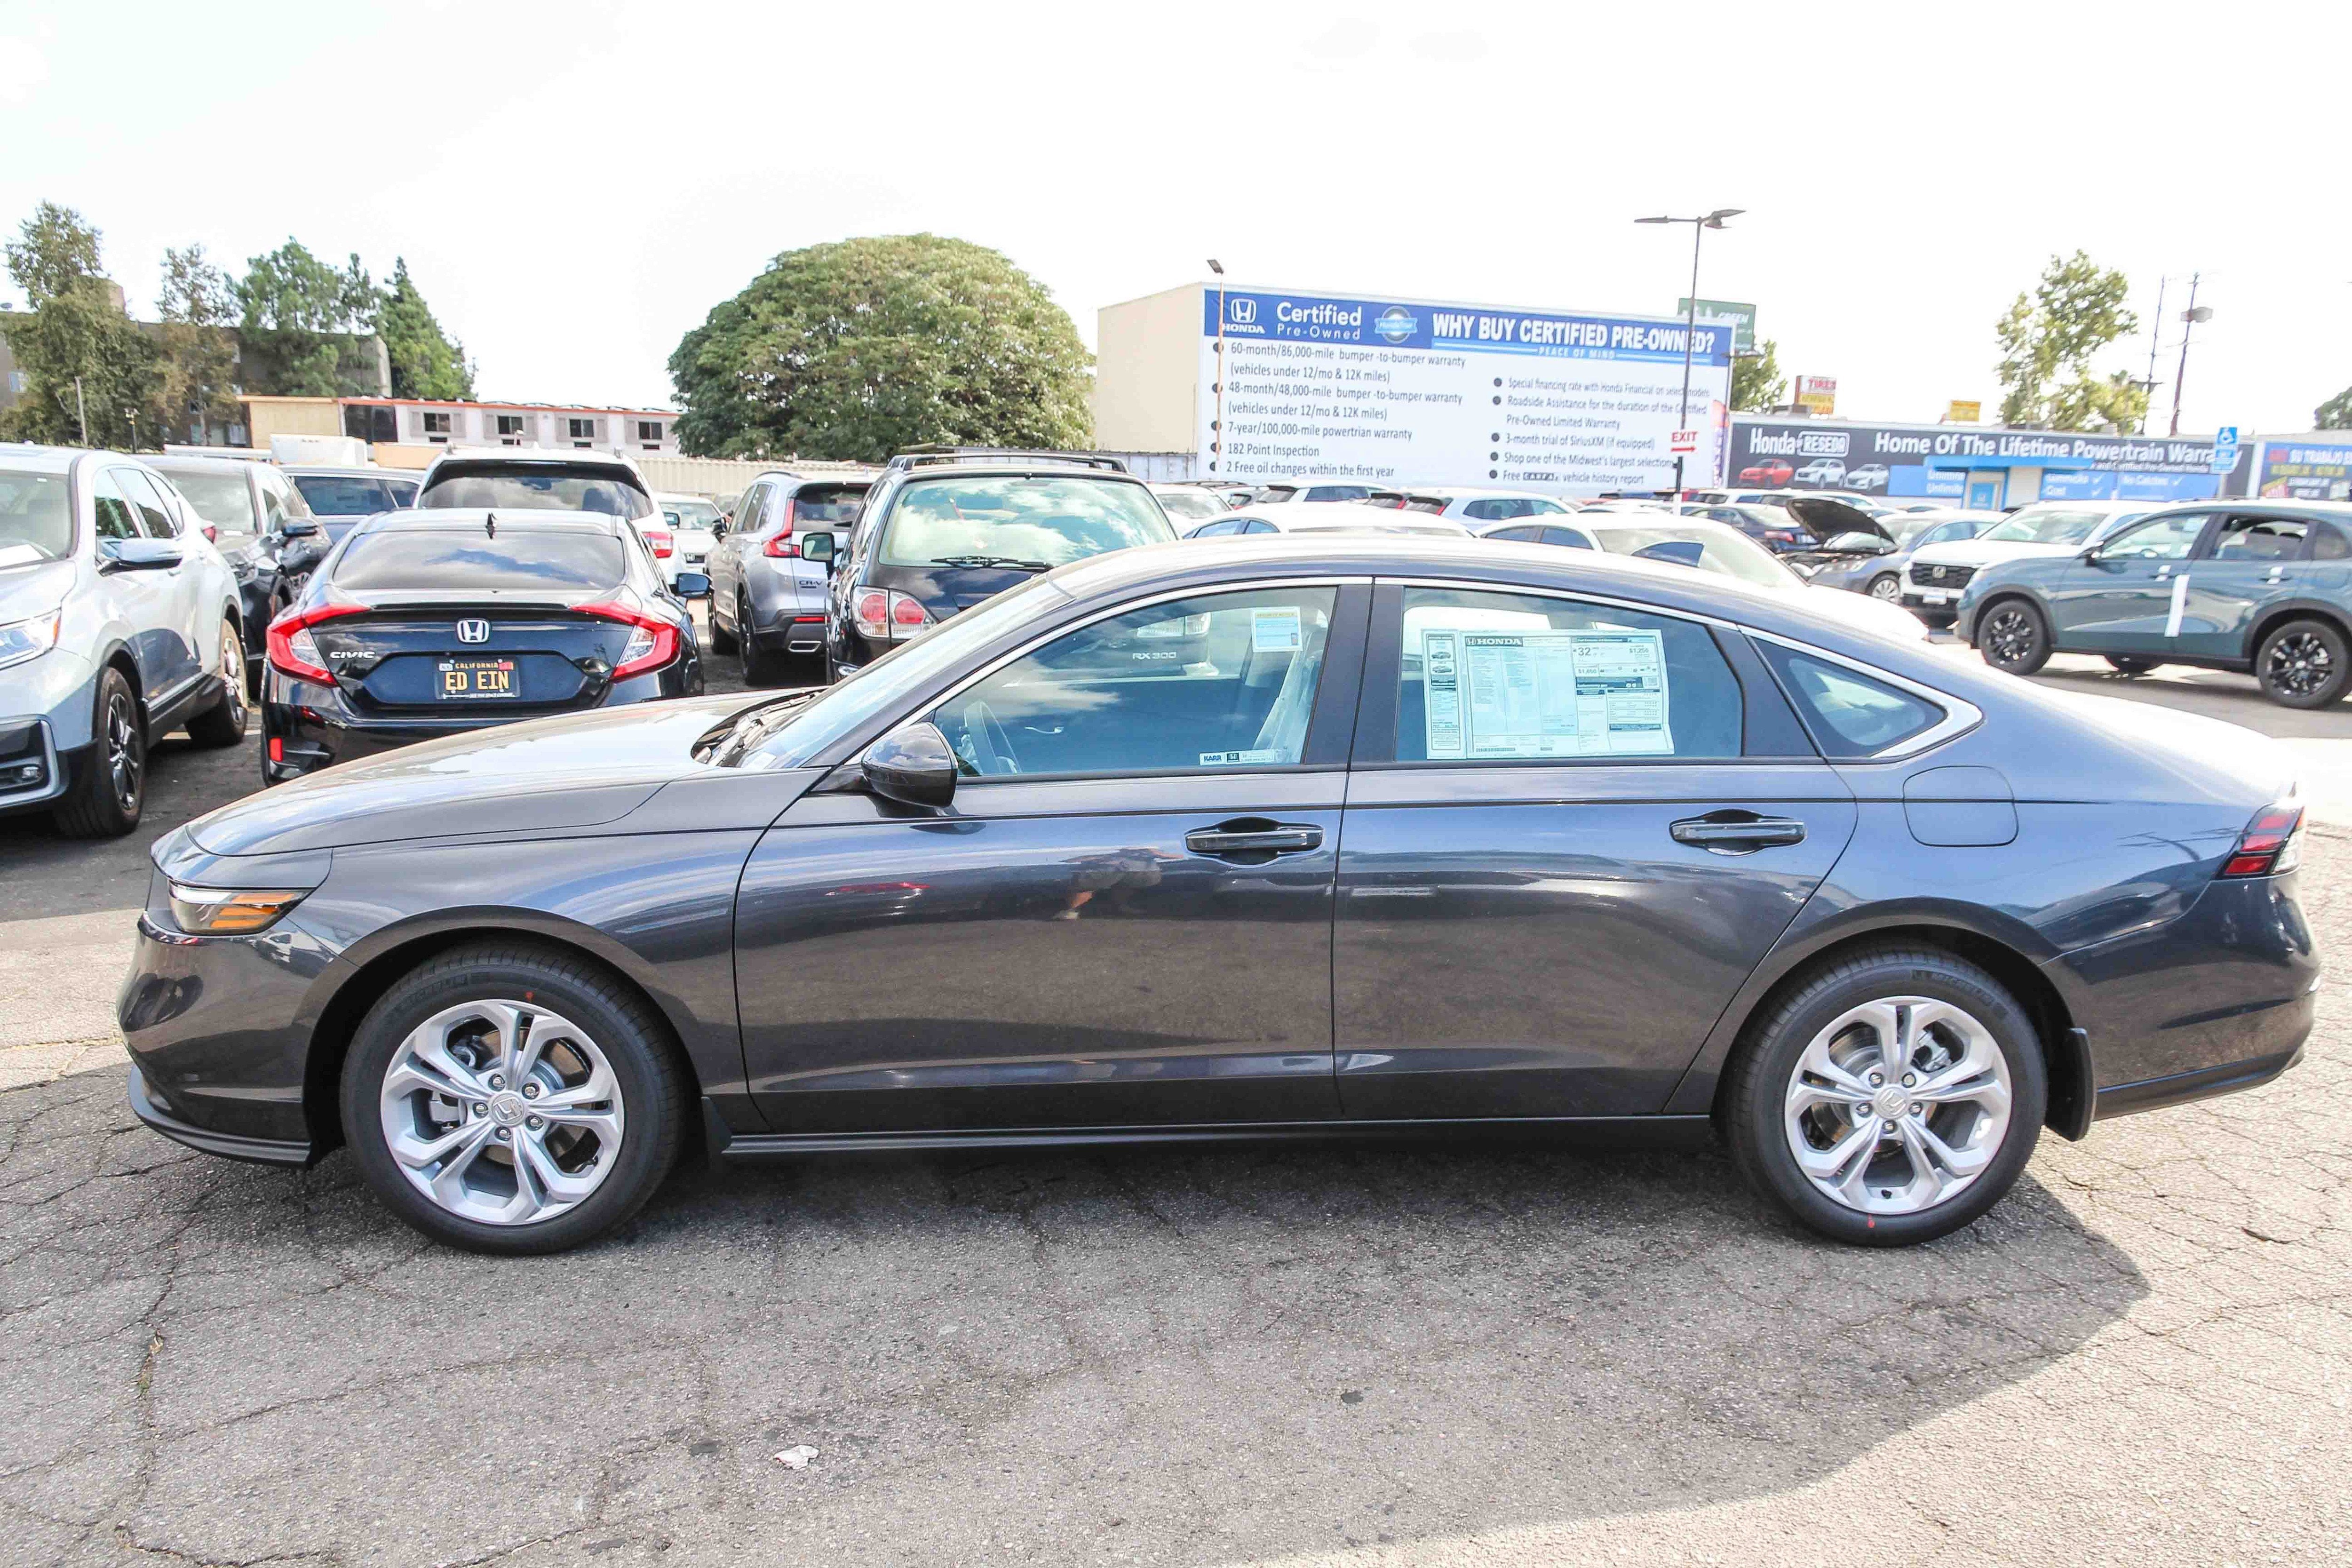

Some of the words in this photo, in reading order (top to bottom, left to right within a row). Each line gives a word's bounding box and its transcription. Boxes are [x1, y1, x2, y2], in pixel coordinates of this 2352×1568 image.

[1277, 301, 1362, 326] Certified
[1222, 323, 1265, 334] HONDA
[1277, 323, 1360, 341] Pre-Owned
[1432, 313, 1475, 339] WHY
[1478, 316, 1516, 342] BUY
[1519, 319, 1608, 347] CERTIFIED
[1231, 343, 1334, 359] 60-month/86,000-mile
[1339, 348, 1374, 362] bumper
[1428, 356, 1466, 369] warranty
[1538, 346, 1569, 357] PEACE
[1572, 348, 1585, 358] OF
[1589, 349, 1616, 359] MIND
[1231, 362, 1271, 375] (vehicles
[1273, 366, 1300, 377] under
[1303, 366, 1333, 380] 12/mo
[1335, 368, 1342, 379] &
[1345, 369, 1361, 380] 12K
[1364, 370, 1390, 384] miles)
[1228, 381, 1331, 398] 48-month/48,000-mile
[1336, 386, 1371, 400] bumper
[1424, 393, 1462, 406] warranty
[1666, 387, 1685, 397] selec
[1228, 401, 1268, 415] (vehicles
[1271, 404, 1297, 415] under
[1301, 405, 1330, 418] 12/mo
[1333, 406, 1340, 417] &
[1343, 406, 1359, 418] 12K
[1361, 408, 1388, 421] miles)
[1507, 395, 1544, 407] Roadside
[1546, 398, 1587, 408] Assistance
[1589, 398, 1600, 410] for
[1602, 401, 1614, 410] the
[1616, 400, 1650, 411] duration
[1675, 403, 1708, 414] Cetified
[1228, 421, 1320, 436] 7-year/100,000-mile
[1374, 430, 1412, 441] warranty
[1506, 414, 1551, 426] Pre-Owned
[1553, 416, 1583, 428] Limited
[1585, 417, 1620, 431] Warranty
[1506, 432, 1540, 444] 3-month
[1542, 434, 1558, 445] trial
[1559, 435, 1569, 446] of
[1570, 435, 1604, 446] SiriusXM
[1671, 431, 1698, 443] EXIT
[1748, 427, 1796, 455] Honda
[1802, 436, 1846, 453] RESEDA
[1228, 443, 1244, 454] 182
[1247, 443, 1271, 455] Point
[1273, 444, 1319, 459] Inspection
[1874, 432, 1931, 454] Home
[1934, 433, 1960, 455] Of
[1962, 434, 1996, 456] The
[1999, 436, 2070, 458] Lifetime
[2072, 439, 2165, 461] Powertrain
[1504, 451, 1524, 464] Shop
[1526, 455, 1542, 463] one
[1543, 453, 1552, 464] of
[1554, 453, 1566, 464] the
[1227, 461, 1232, 472] 2
[1235, 462, 1255, 473] Free
[1257, 462, 1268, 473] oil
[1271, 462, 1306, 477] changes
[1310, 463, 1337, 475] within
[1340, 463, 1354, 476] the
[1357, 464, 1374, 476] first
[1376, 468, 1394, 478] year
[1503, 470, 1521, 480] Free
[1563, 472, 1590, 483] vehicle
[1620, 475, 1644, 485] report
[1578, 647, 1591, 656] 32
[445, 671, 468, 691] ED
[477, 670, 509, 690] EIN
